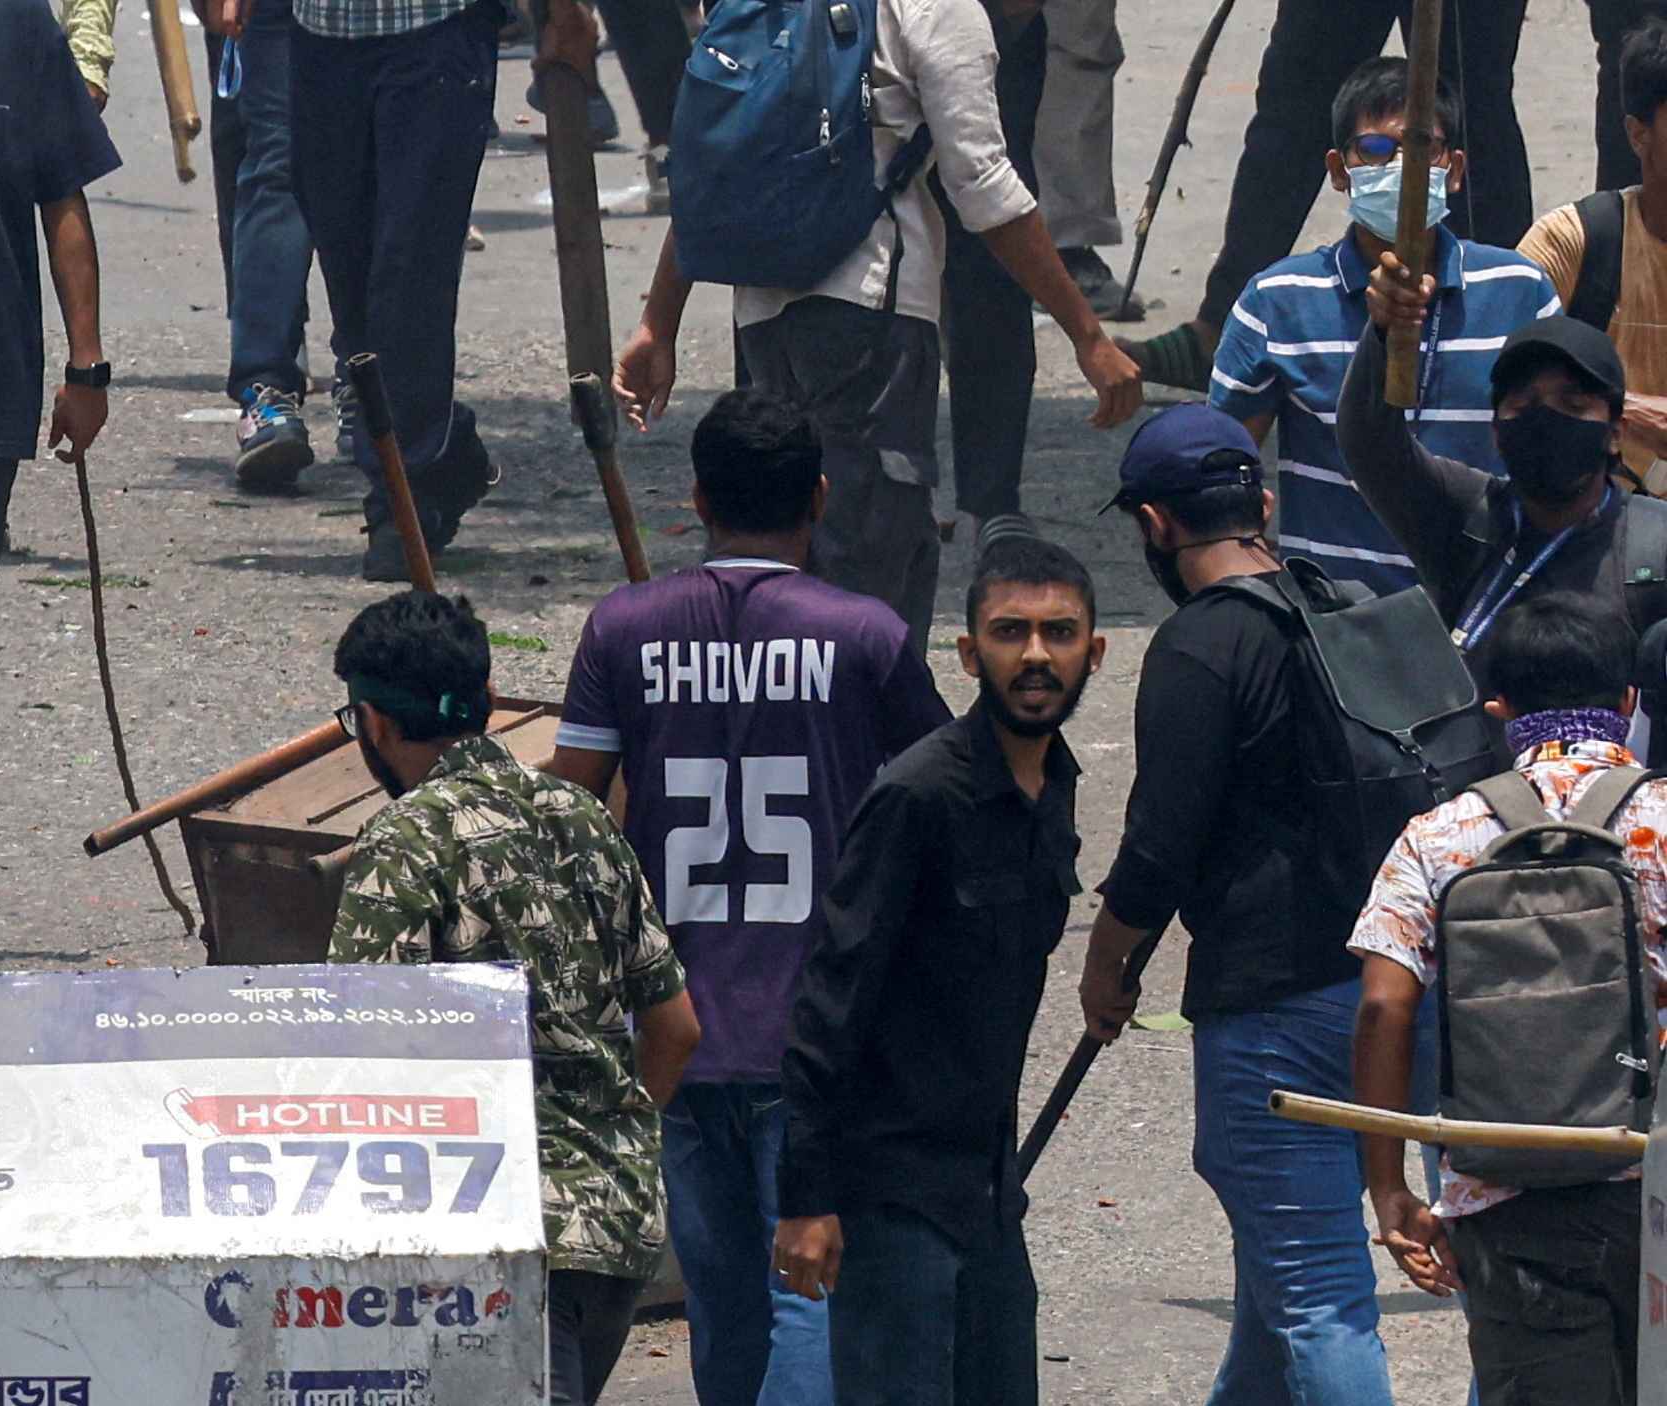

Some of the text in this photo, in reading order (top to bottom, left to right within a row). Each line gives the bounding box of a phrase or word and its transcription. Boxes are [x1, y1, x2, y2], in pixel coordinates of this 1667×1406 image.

[641, 638, 835, 703] SHOVON
[664, 756, 812, 925] 25
[236, 1103, 446, 1127] HOTLINE
[142, 1141, 505, 1217] 16797
